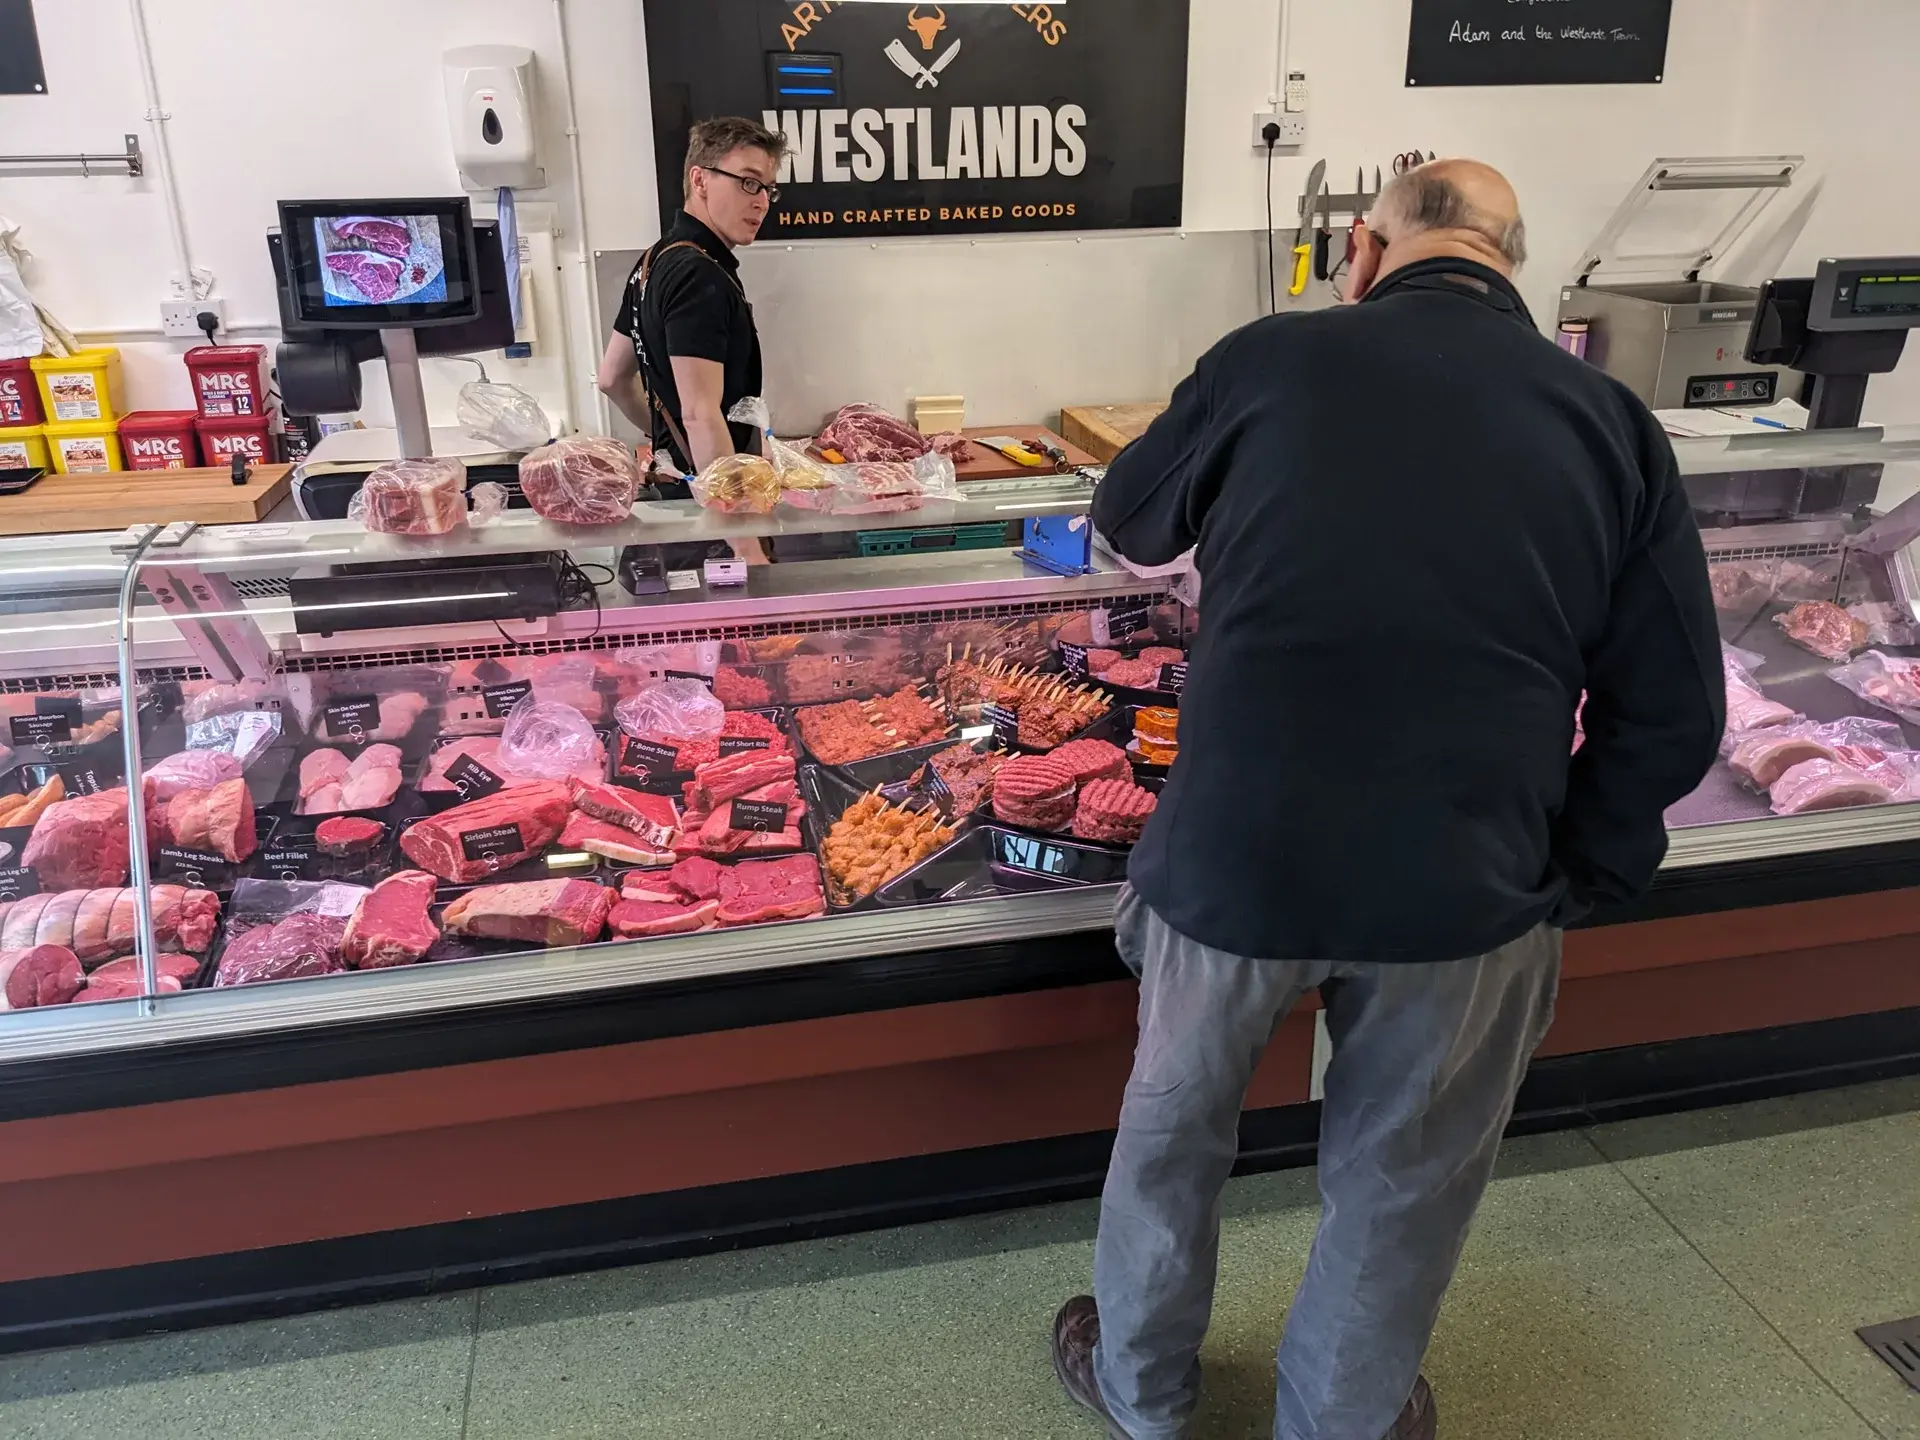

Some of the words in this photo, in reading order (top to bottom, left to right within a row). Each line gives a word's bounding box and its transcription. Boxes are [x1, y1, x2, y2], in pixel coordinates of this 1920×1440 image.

[1449, 20, 1491, 43] Adam
[1501, 24, 1526, 41] and
[1535, 24, 1554, 40] the
[762, 104, 1087, 184] WESTLANDS
[779, 211, 834, 226] HAND
[843, 208, 931, 224] CRAFTED
[940, 206, 1003, 221] BAKED
[1012, 203, 1077, 218] GOODS
[199, 372, 250, 391] MRC
[5, 402, 21, 415] 24
[236, 396, 250, 409] 12
[132, 439, 182, 456] MRC
[212, 436, 262, 454] MRC
[349, 702, 371, 710] Chicken
[630, 741, 655, 753] T-Bone
[656, 746, 676, 758] Steak
[86, 769, 102, 793] Topsid
[467, 763, 479, 775] Rib
[479, 771, 492, 783] Eye
[736, 802, 760, 812] Rump
[760, 805, 784, 814] Steak
[464, 831, 492, 842] Sirloin
[493, 827, 517, 837] Steak
[161, 848, 184, 858] Lamb
[184, 851, 198, 861] Leg
[198, 854, 225, 864] Steaks
[264, 852, 285, 860] Beef
[286, 851, 309, 860] Fillet
